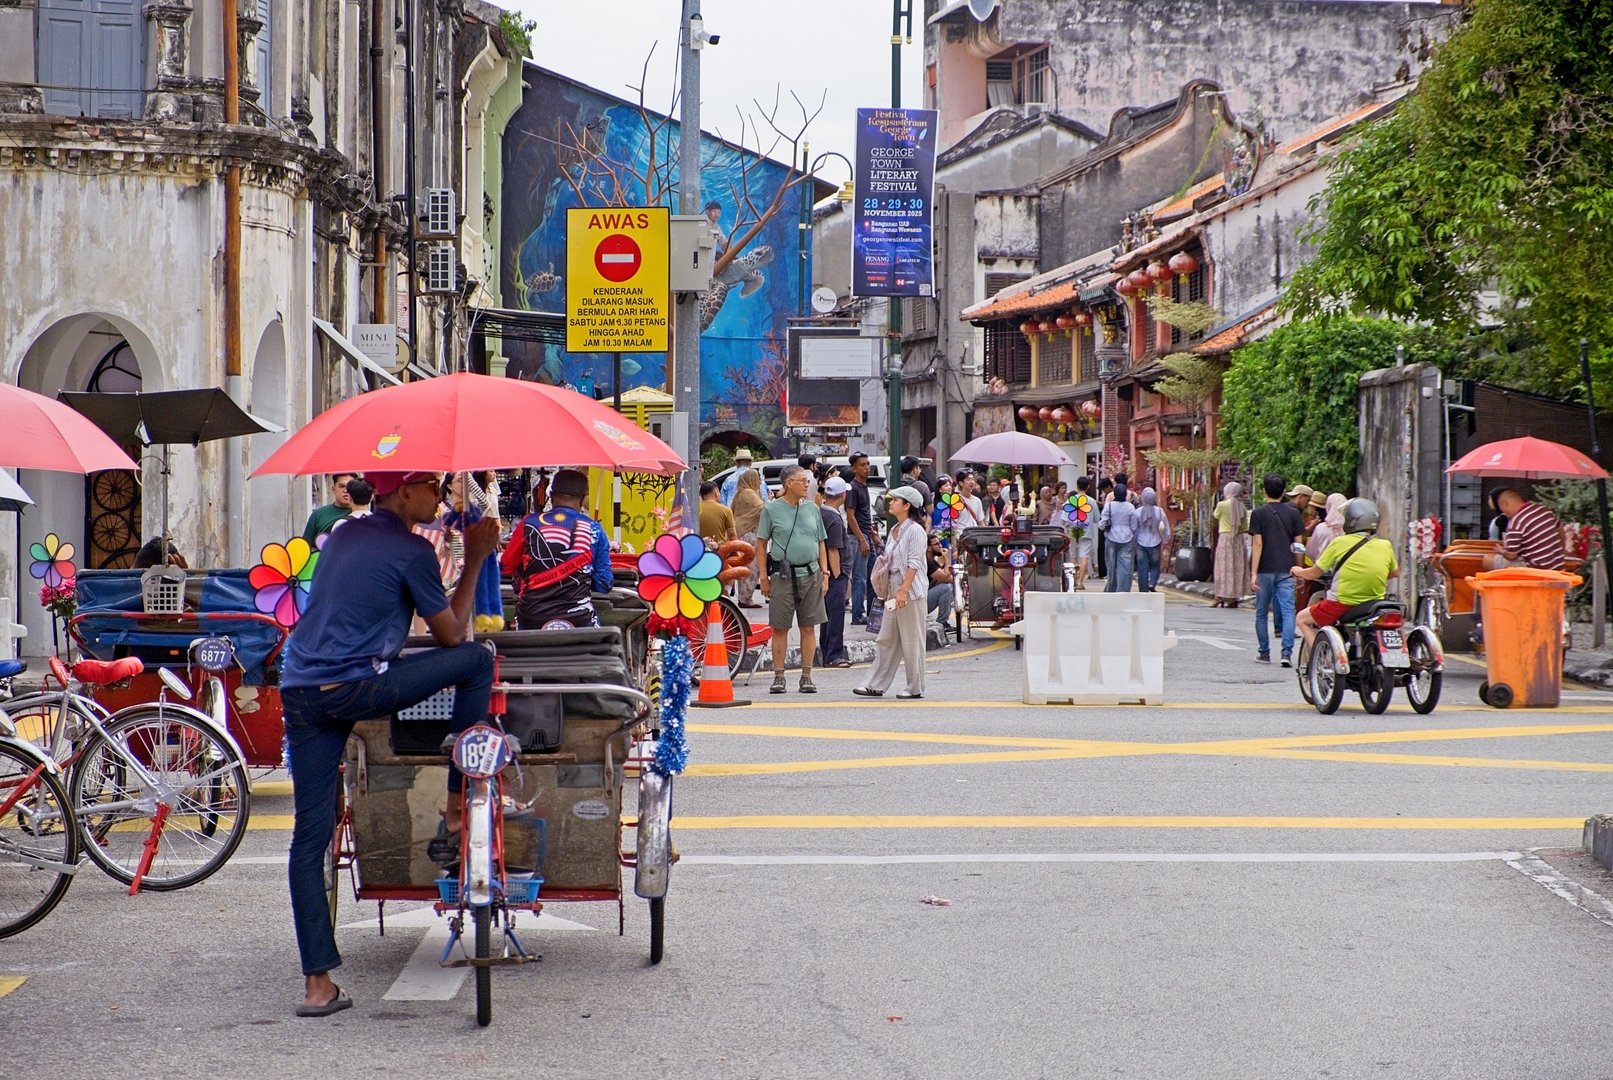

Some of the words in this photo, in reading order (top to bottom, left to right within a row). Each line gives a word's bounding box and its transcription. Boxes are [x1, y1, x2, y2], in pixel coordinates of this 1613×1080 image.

[875, 110, 907, 118] Festival
[879, 125, 911, 136] George
[870, 147, 915, 157] GEORGE
[870, 159, 902, 168] TOWN
[870, 170, 919, 180] LITERARY
[869, 181, 917, 191] FESTIVAL
[864, 198, 879, 209] 28
[888, 198, 901, 209] 29
[909, 198, 923, 209] 30
[863, 209, 907, 217] NOVEMBER
[587, 213, 650, 230] AWAS
[593, 287, 643, 295] KENDERAAN
[582, 297, 623, 306] DILARANG
[625, 297, 654, 306] MASUK
[577, 308, 617, 316] BERMULA
[618, 308, 637, 316] DARI
[639, 308, 659, 316] HARI
[569, 318, 597, 326] SABTU
[598, 318, 616, 326] JAM
[634, 318, 666, 326] PETANG
[360, 333, 387, 341] MINI
[589, 328, 620, 337] HINGGA
[621, 328, 645, 337] AHAD
[583, 339, 600, 347] JAM
[602, 339, 622, 347] 10.30
[623, 339, 653, 347] MALAM
[201, 650, 226, 662] 6877
